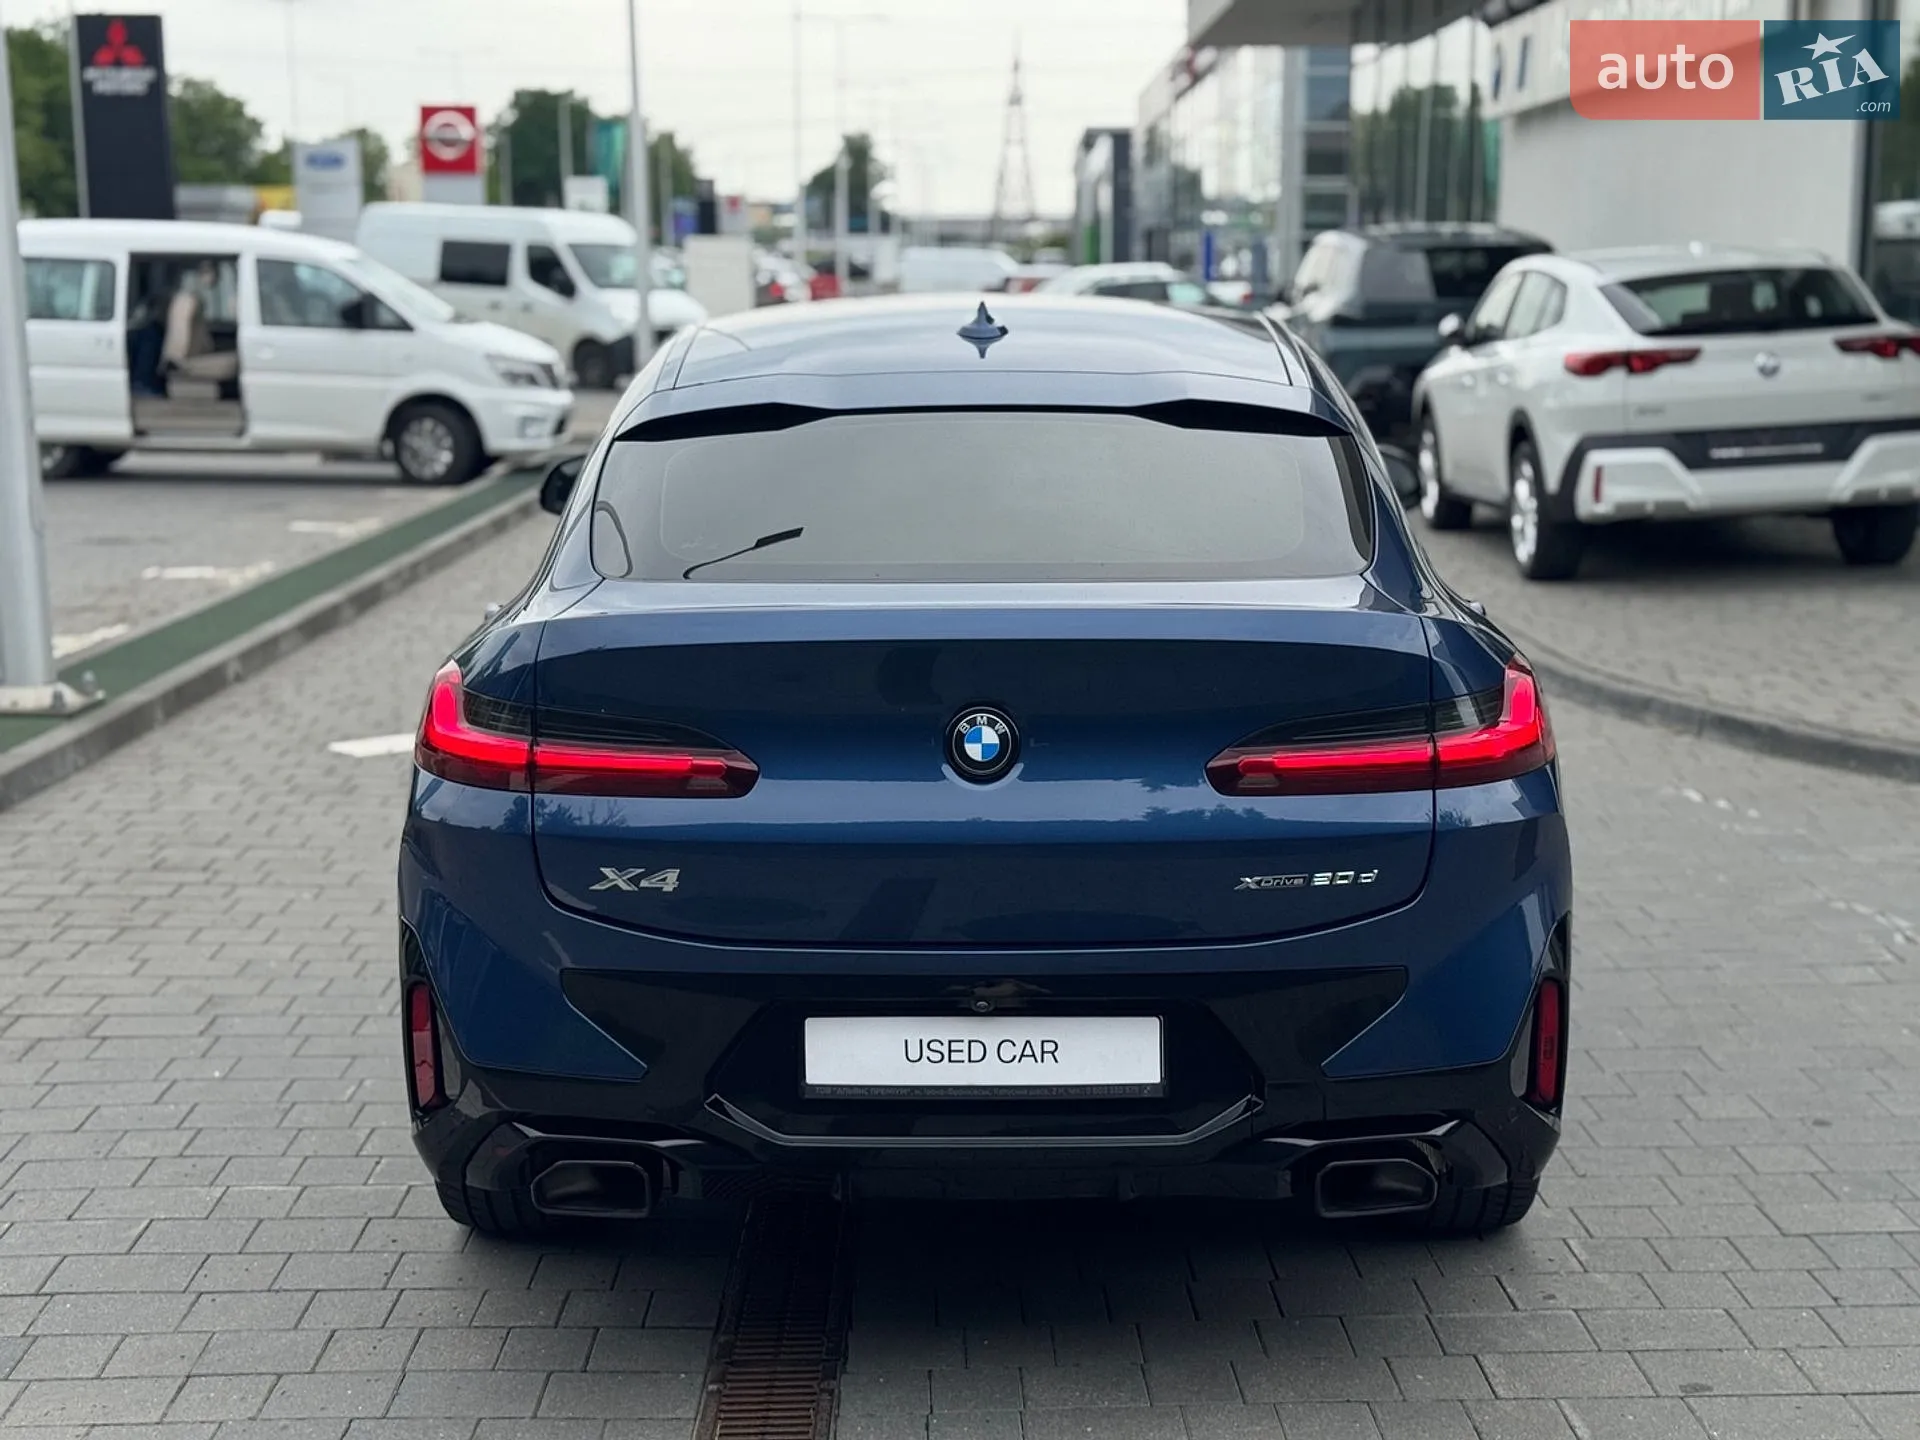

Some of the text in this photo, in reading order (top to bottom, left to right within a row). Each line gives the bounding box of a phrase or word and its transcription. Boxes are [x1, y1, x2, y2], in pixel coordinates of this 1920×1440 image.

[959, 715, 1006, 735] BMW
[588, 867, 680, 892] X4
[904, 1038, 1059, 1064] USED CAR
